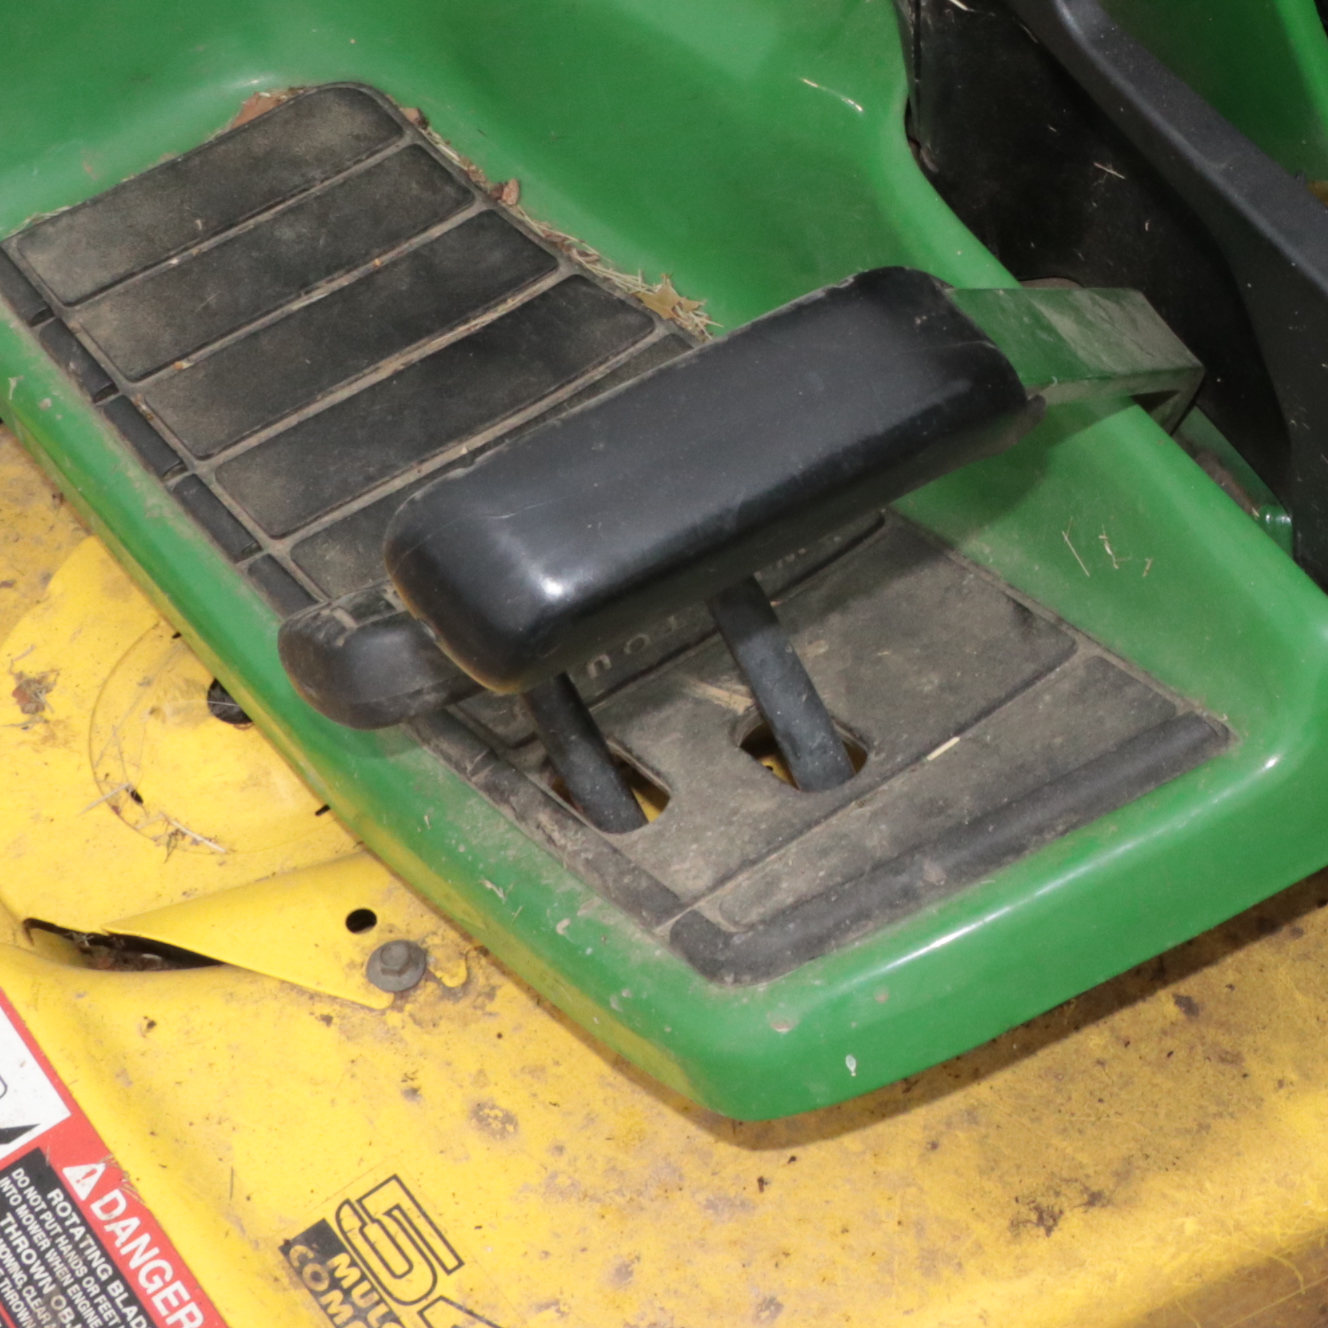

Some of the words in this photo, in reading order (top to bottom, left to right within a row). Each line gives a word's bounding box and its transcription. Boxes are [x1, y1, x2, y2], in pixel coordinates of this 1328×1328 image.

[0, 1176, 23, 1207] INTO
[14, 1203, 51, 1251] MOWER
[43, 1248, 74, 1287] WHEN
[66, 1283, 103, 1328] ENGINE
[0, 1212, 57, 1295] THROWN
[10, 1167, 30, 1189] DO
[22, 1185, 46, 1214] NOT
[38, 1210, 62, 1237] PUT
[54, 1234, 88, 1278] HANDS
[80, 1274, 101, 1297] OR
[93, 1294, 120, 1328] FEET
[45, 1187, 114, 1282] ROTATING
[20, 1284, 53, 1324] CLEAR
[326, 1252, 401, 1328] MUL
